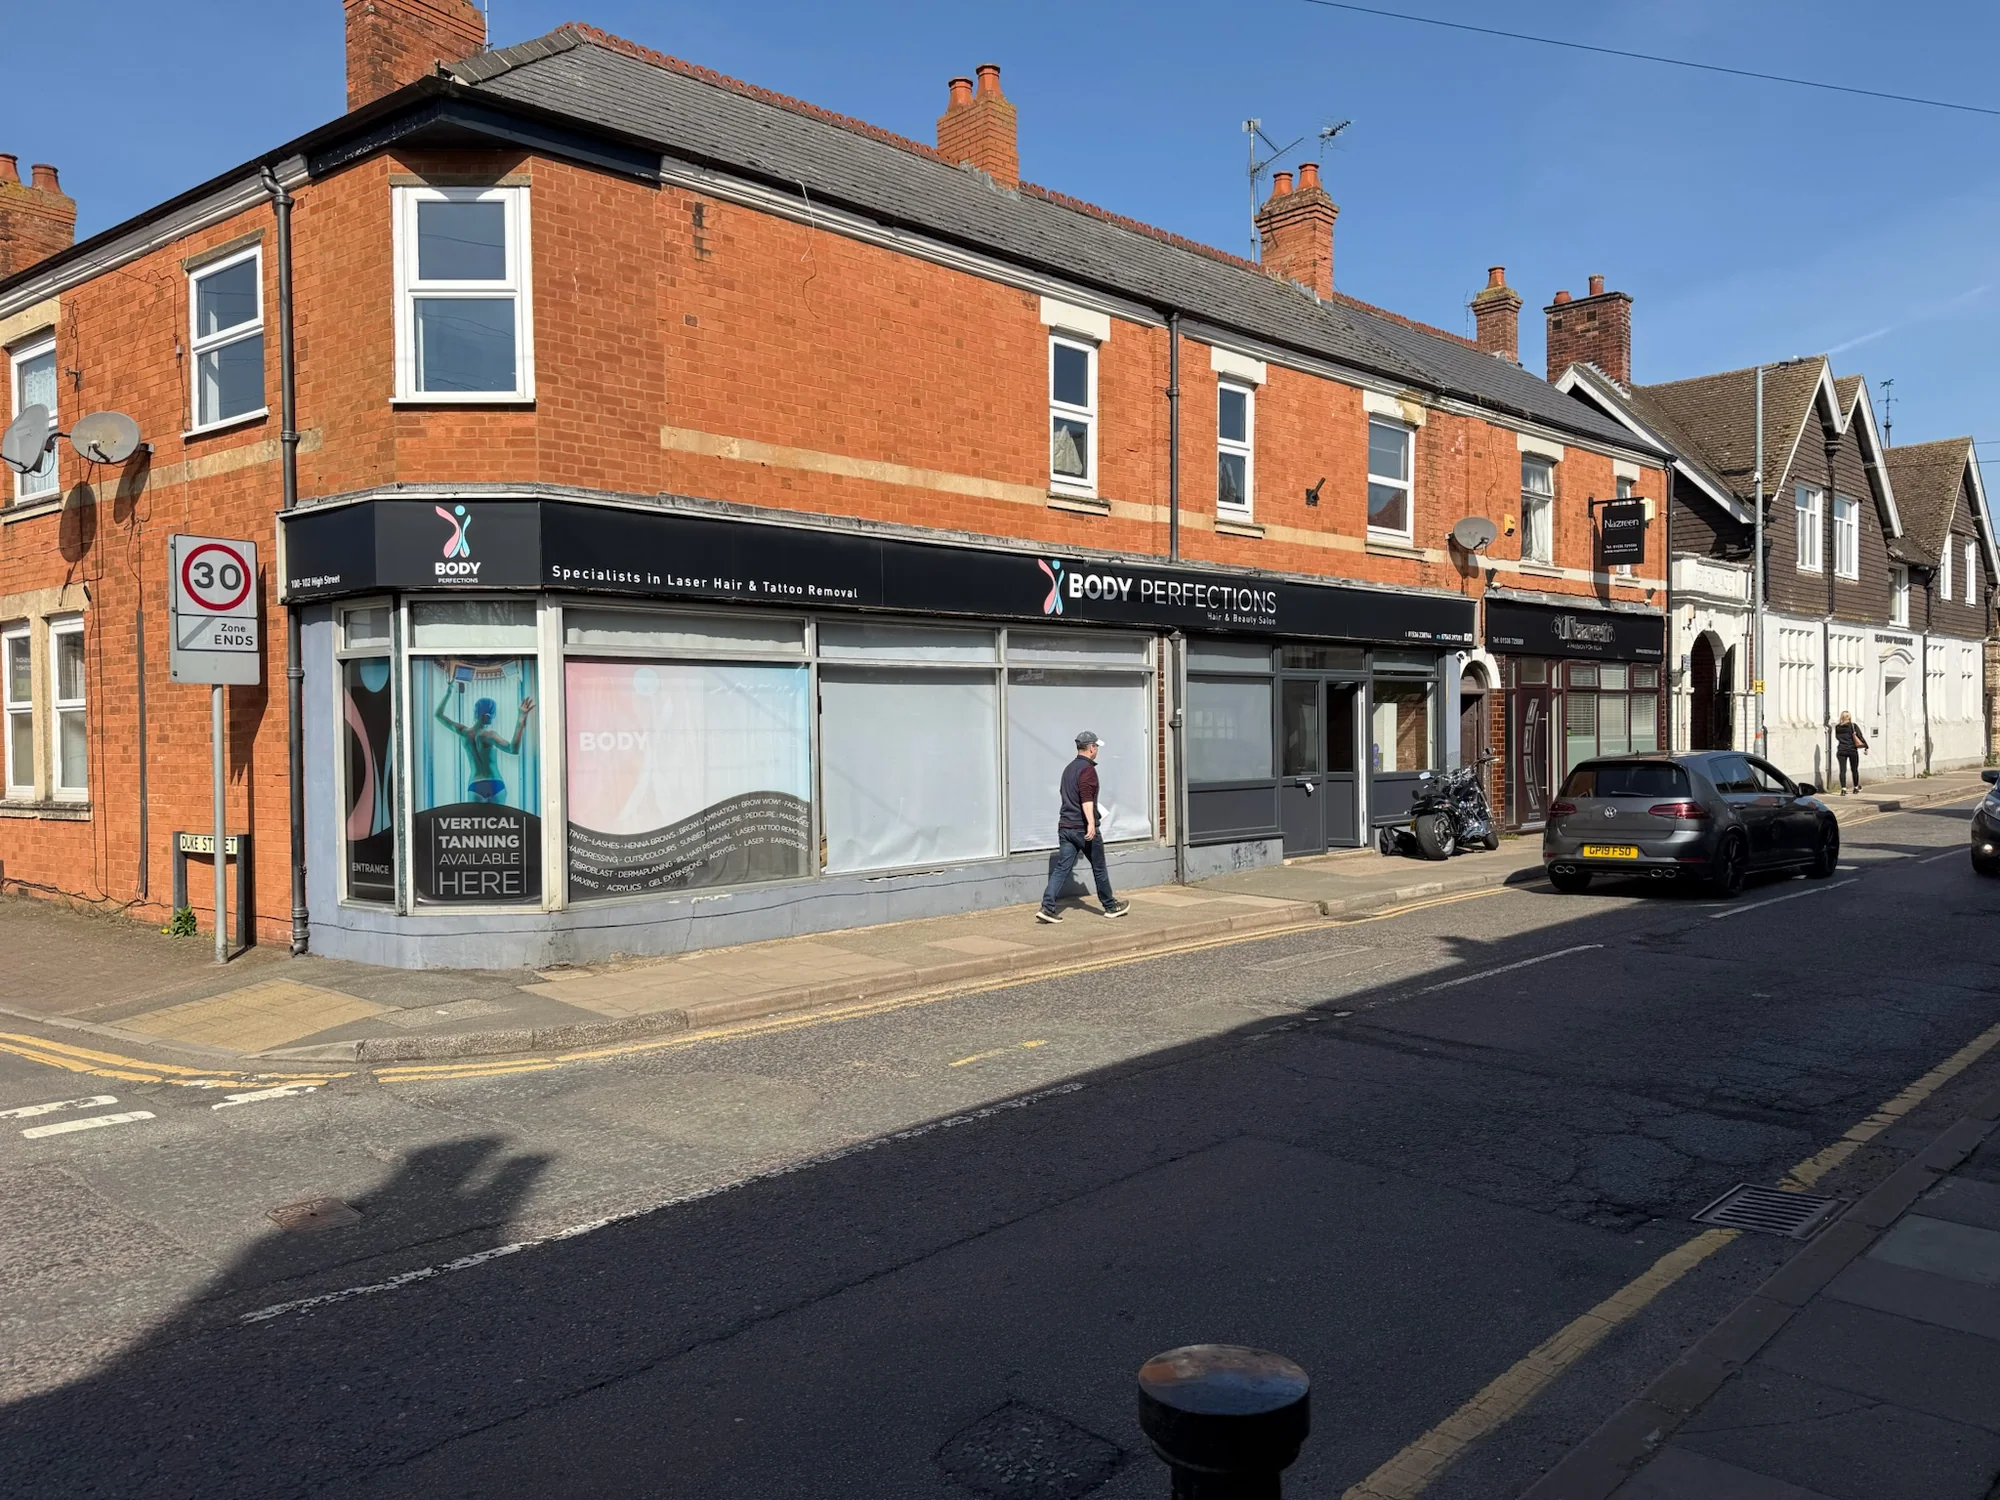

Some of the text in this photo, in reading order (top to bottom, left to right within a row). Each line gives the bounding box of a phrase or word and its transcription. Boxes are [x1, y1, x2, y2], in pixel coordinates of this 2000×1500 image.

[1604, 519, 1639, 528] Nazreen
[193, 562, 241, 590] 30
[435, 562, 481, 576] BODY
[291, 575, 341, 589] 100-102 High Street
[552, 565, 858, 599] Specialists in Laser Hair & Tattoo Removal
[1069, 572, 1277, 614] BODY PERFECTIONS
[1207, 611, 1276, 626] Hair & Beauty Salon
[221, 623, 246, 633] Zone
[214, 634, 254, 646] ENDS
[579, 731, 649, 751] BODY
[438, 817, 519, 830] VERTICAL
[569, 829, 589, 842] TINTS
[591, 838, 620, 850] LASHES
[624, 840, 651, 850] HENNA
[650, 831, 677, 846] BROWS
[679, 820, 701, 835] BROW
[699, 804, 738, 825] LAMINATION
[741, 799, 761, 808] BROW
[784, 801, 808, 814] FACIALS
[182, 836, 236, 852] DUKE STET
[438, 835, 520, 849] TANNING
[624, 844, 677, 864] CUTS/COLOURS
[680, 830, 706, 847] SUNBED
[708, 814, 742, 832] MANICURE
[744, 811, 776, 820] PEDICURE
[779, 812, 810, 828] MASSAGES
[570, 859, 614, 878] FIBROBLAST
[618, 860, 673, 878] DERMAPLANING
[676, 854, 687, 863] IPL
[686, 846, 702, 858] HAIR
[702, 833, 732, 851] REMOVAL
[735, 825, 756, 837] LASER
[781, 825, 808, 840] REMOVAL
[1589, 846, 1610, 855] GP19
[439, 853, 520, 865] AVAILABLE
[570, 873, 599, 889] WAXING
[606, 883, 642, 892] ACRYLICS
[648, 878, 663, 888] GEL
[662, 860, 703, 883] EXTENSIONS
[709, 843, 738, 860] ACRYGEL
[743, 837, 765, 847] LASER
[352, 862, 389, 874] ENTRANCE
[439, 871, 521, 895] HERE
